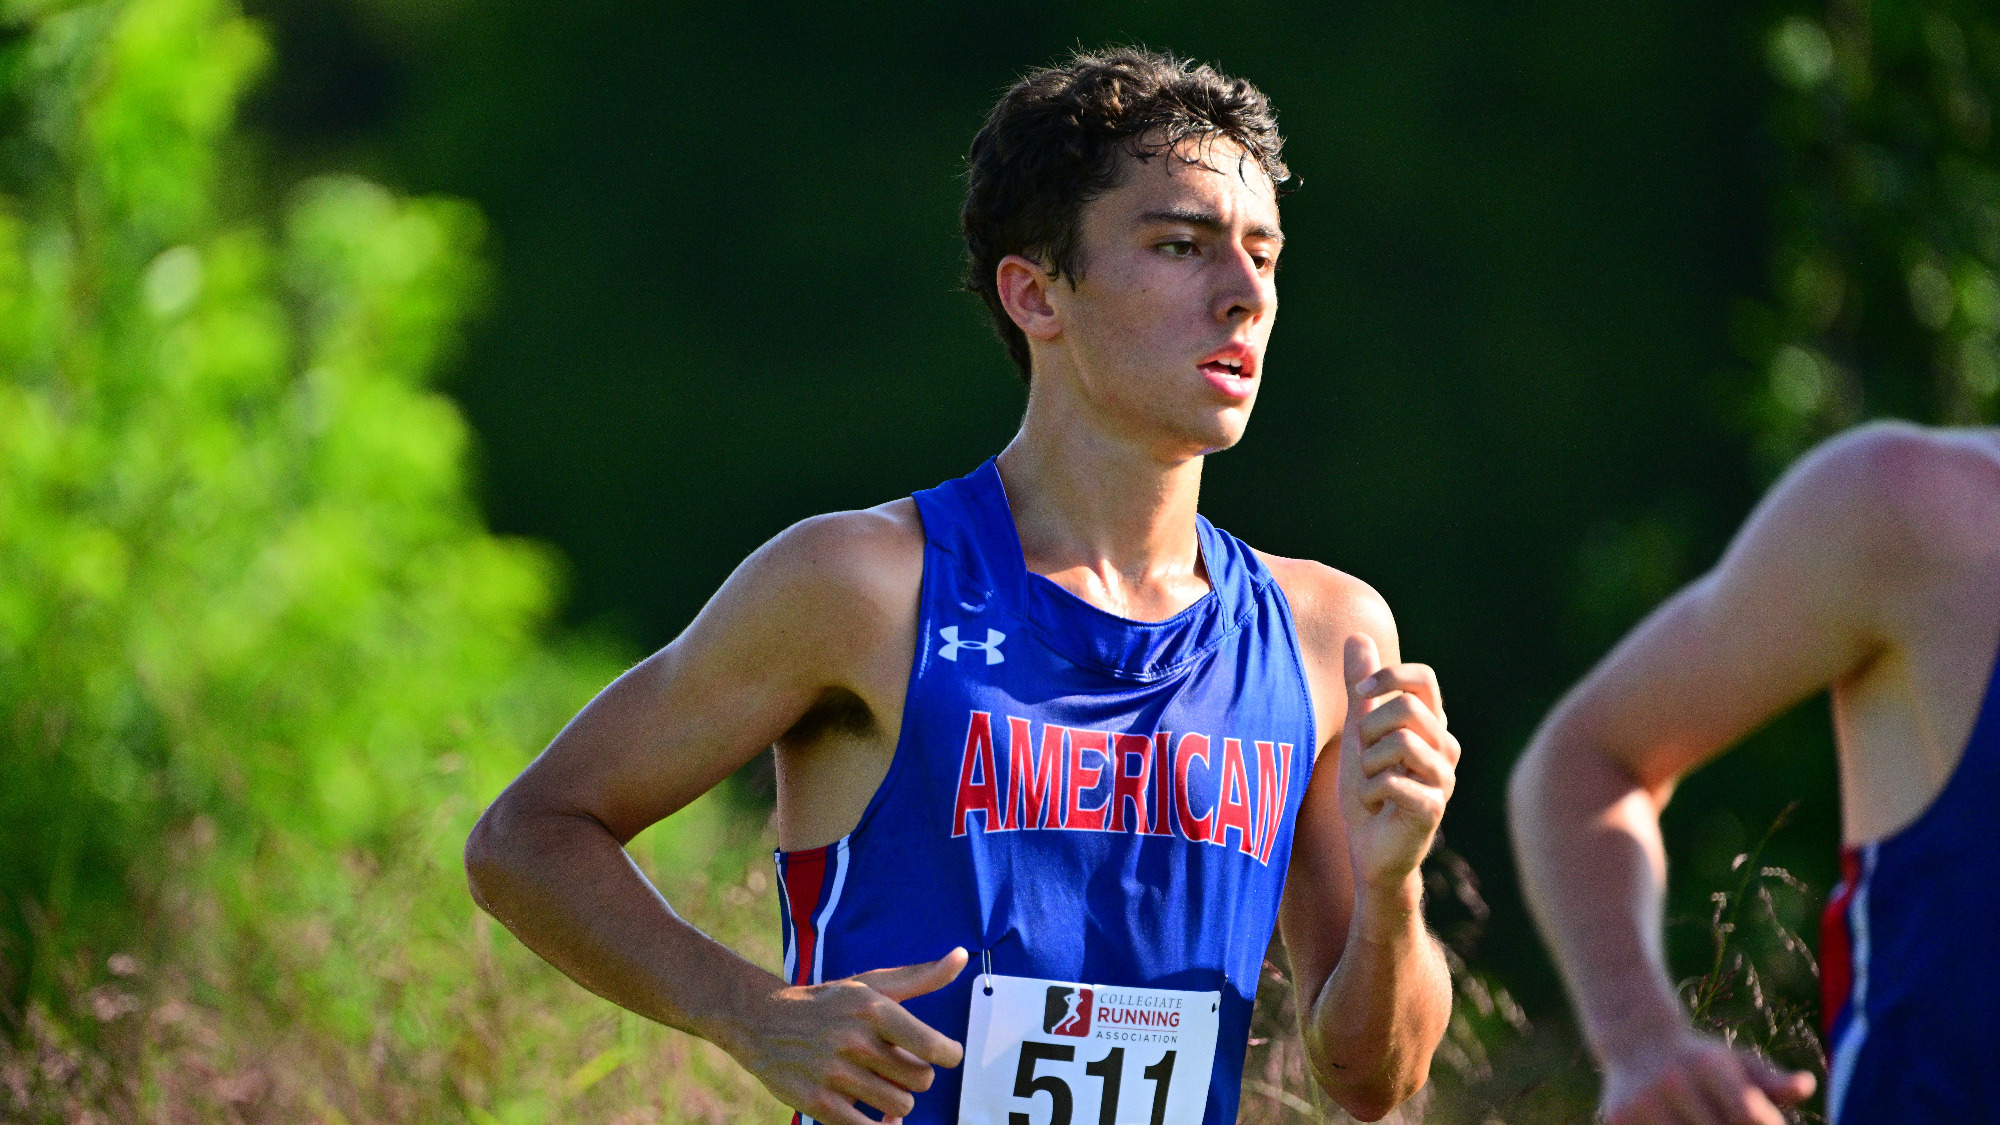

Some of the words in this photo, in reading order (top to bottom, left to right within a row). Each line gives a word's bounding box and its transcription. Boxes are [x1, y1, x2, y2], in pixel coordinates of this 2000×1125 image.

[951, 710, 1293, 866] AMERICAN
[1100, 992, 1183, 1009] COLLEGIATE
[1097, 1007, 1180, 1028] RUNNING
[1096, 1031, 1178, 1044] ASSOCIATION
[1008, 1040, 1177, 1125] 511
